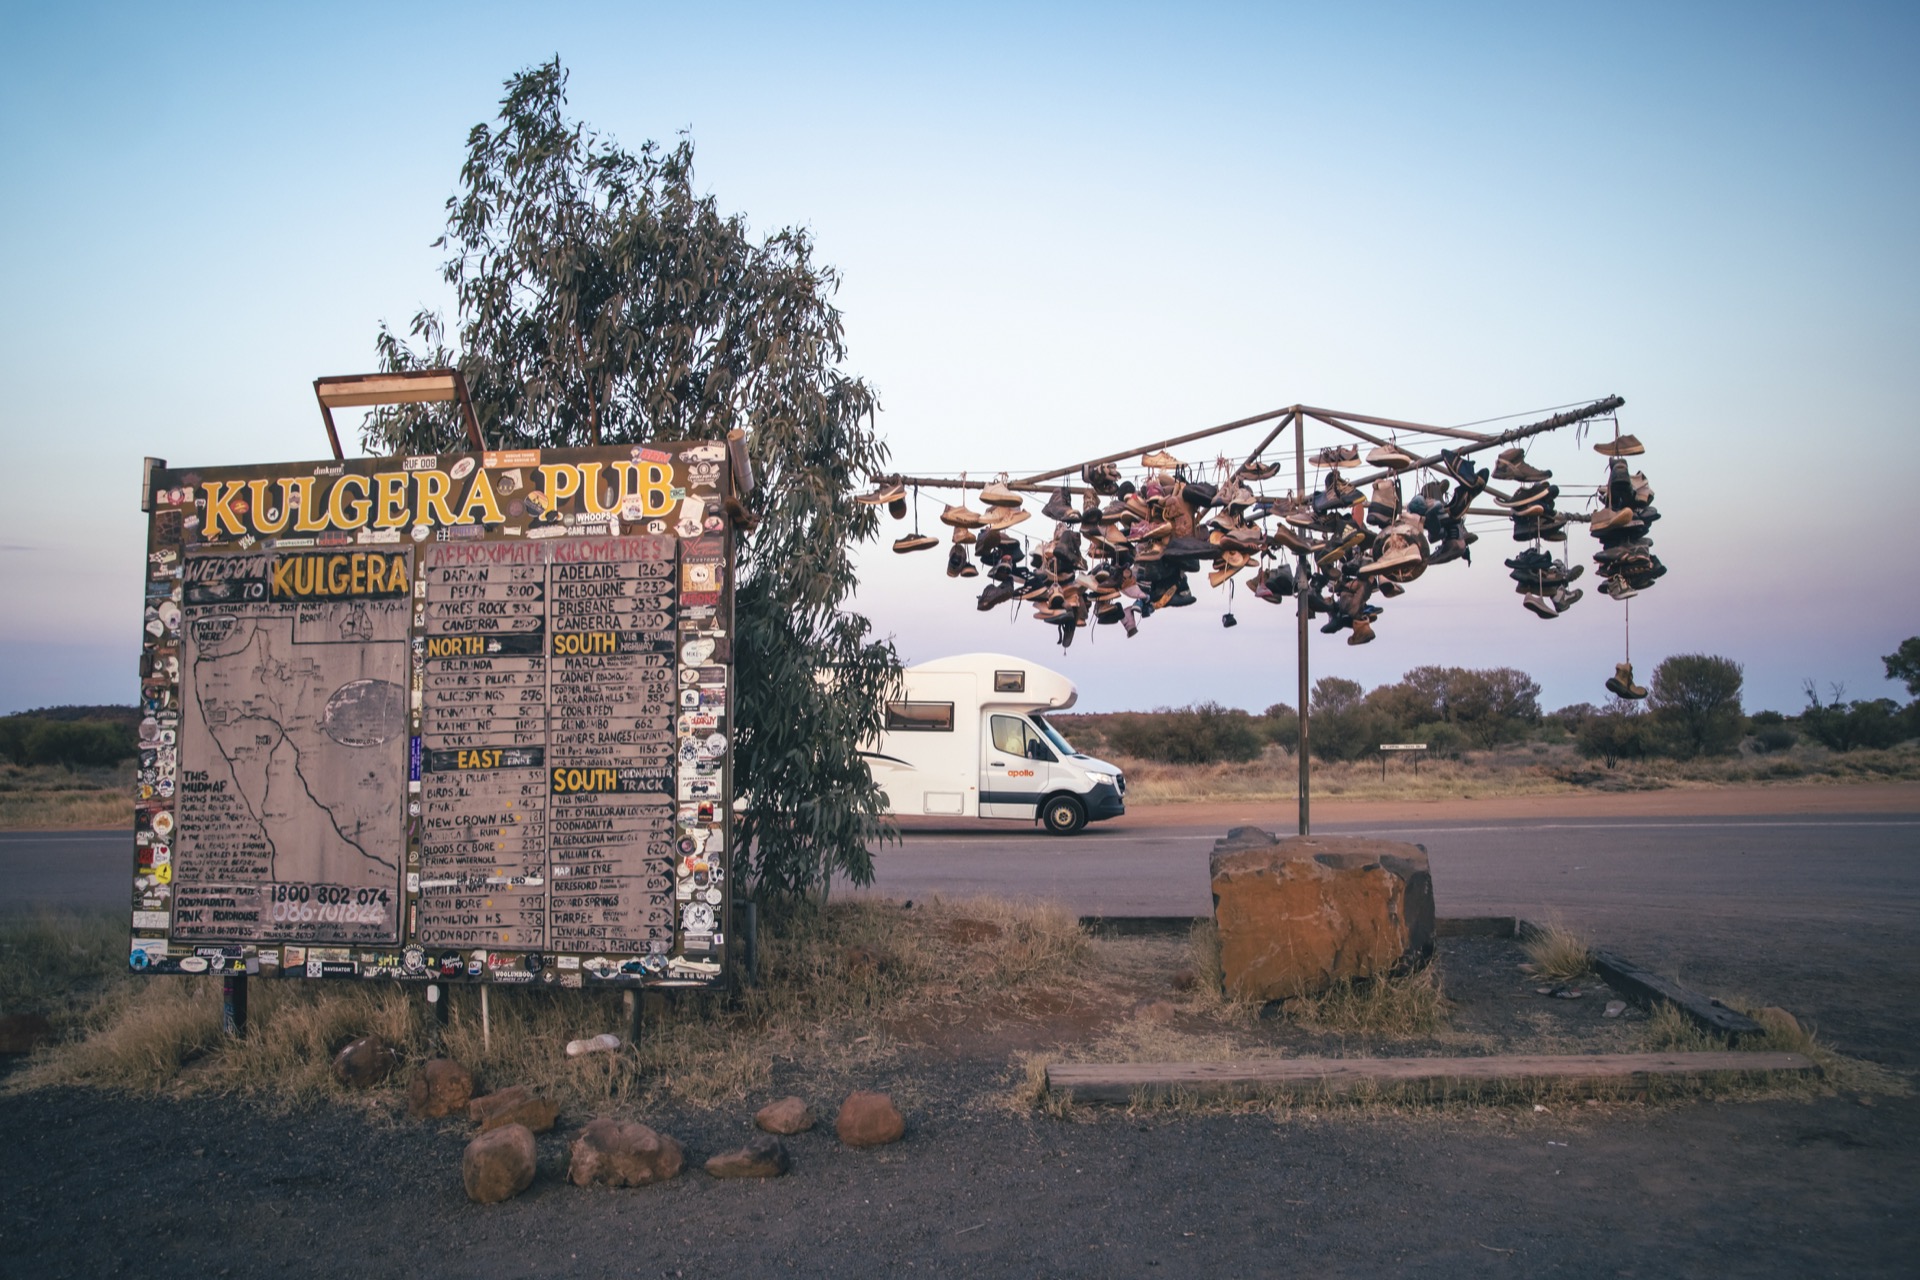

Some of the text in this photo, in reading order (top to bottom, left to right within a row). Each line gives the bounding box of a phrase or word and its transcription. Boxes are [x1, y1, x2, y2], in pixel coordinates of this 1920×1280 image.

[404, 458, 436, 469] RUF 008
[201, 461, 675, 536] KULGERA PUB
[577, 512, 612, 522] WHOOPS
[651, 521, 664, 532] PL
[434, 539, 663, 567] APPROXIMATE KILOMETRES
[243, 553, 409, 599] TO KULGERA
[559, 565, 621, 580] ADELAIDE
[450, 584, 487, 599] PERTH
[558, 581, 626, 598] MELBOURNE
[185, 602, 299, 617] ON THE STUART JUST
[438, 601, 508, 616] AYRES ROCK
[558, 599, 615, 616] BRISBANE
[196, 620, 214, 632] YOU
[556, 614, 622, 631] CANBERRA
[199, 630, 228, 642] HERE!
[428, 636, 485, 658] NORTH
[553, 632, 616, 655] SOUTH
[529, 659, 543, 670] 74
[565, 657, 606, 669] MARLA
[645, 655, 660, 667] 177
[560, 670, 594, 683] CADNEY
[593, 704, 614, 716] PEDY
[641, 703, 661, 716] 409
[634, 719, 654, 730] 662
[598, 729, 632, 743] RANGES
[639, 744, 658, 754] 1156
[457, 749, 503, 769] EAST
[183, 771, 209, 782] THIS
[554, 768, 617, 793] SOUTH
[1007, 769, 1035, 779] apollo
[181, 780, 228, 794] MUDMAP
[622, 779, 665, 792] TRACK
[181, 795, 207, 804] SHOWS
[574, 794, 599, 805] MARLA
[556, 805, 626, 818] MT. O'HALLORAN
[427, 817, 450, 828] NEW
[454, 814, 497, 826] CROWN
[556, 819, 613, 832] OODNADATTA
[480, 827, 500, 838] RUIN
[242, 841, 266, 851] SHOWN
[553, 833, 605, 846] ALGEBUCKINA
[423, 841, 454, 856] BLOODS
[472, 841, 495, 854] BORE
[558, 848, 589, 861] WILLIAM
[647, 842, 668, 856] 620
[455, 855, 497, 865] WATERHOLE
[554, 863, 613, 877] MAP LAKE EYRE
[510, 877, 526, 885] 250
[554, 880, 598, 892] BERESFORD
[272, 885, 311, 904] 1800
[317, 886, 351, 905] 802
[585, 895, 620, 907] SPRINGS
[177, 897, 237, 909] OODNADATTA
[455, 898, 482, 910] BORE
[177, 909, 259, 924] PINK ROADHOUSE
[424, 914, 479, 926] HAMILTON
[557, 926, 608, 937] LYNDHURST
[609, 940, 652, 953] RANGES
[323, 965, 352, 973] NAVIGATOR
